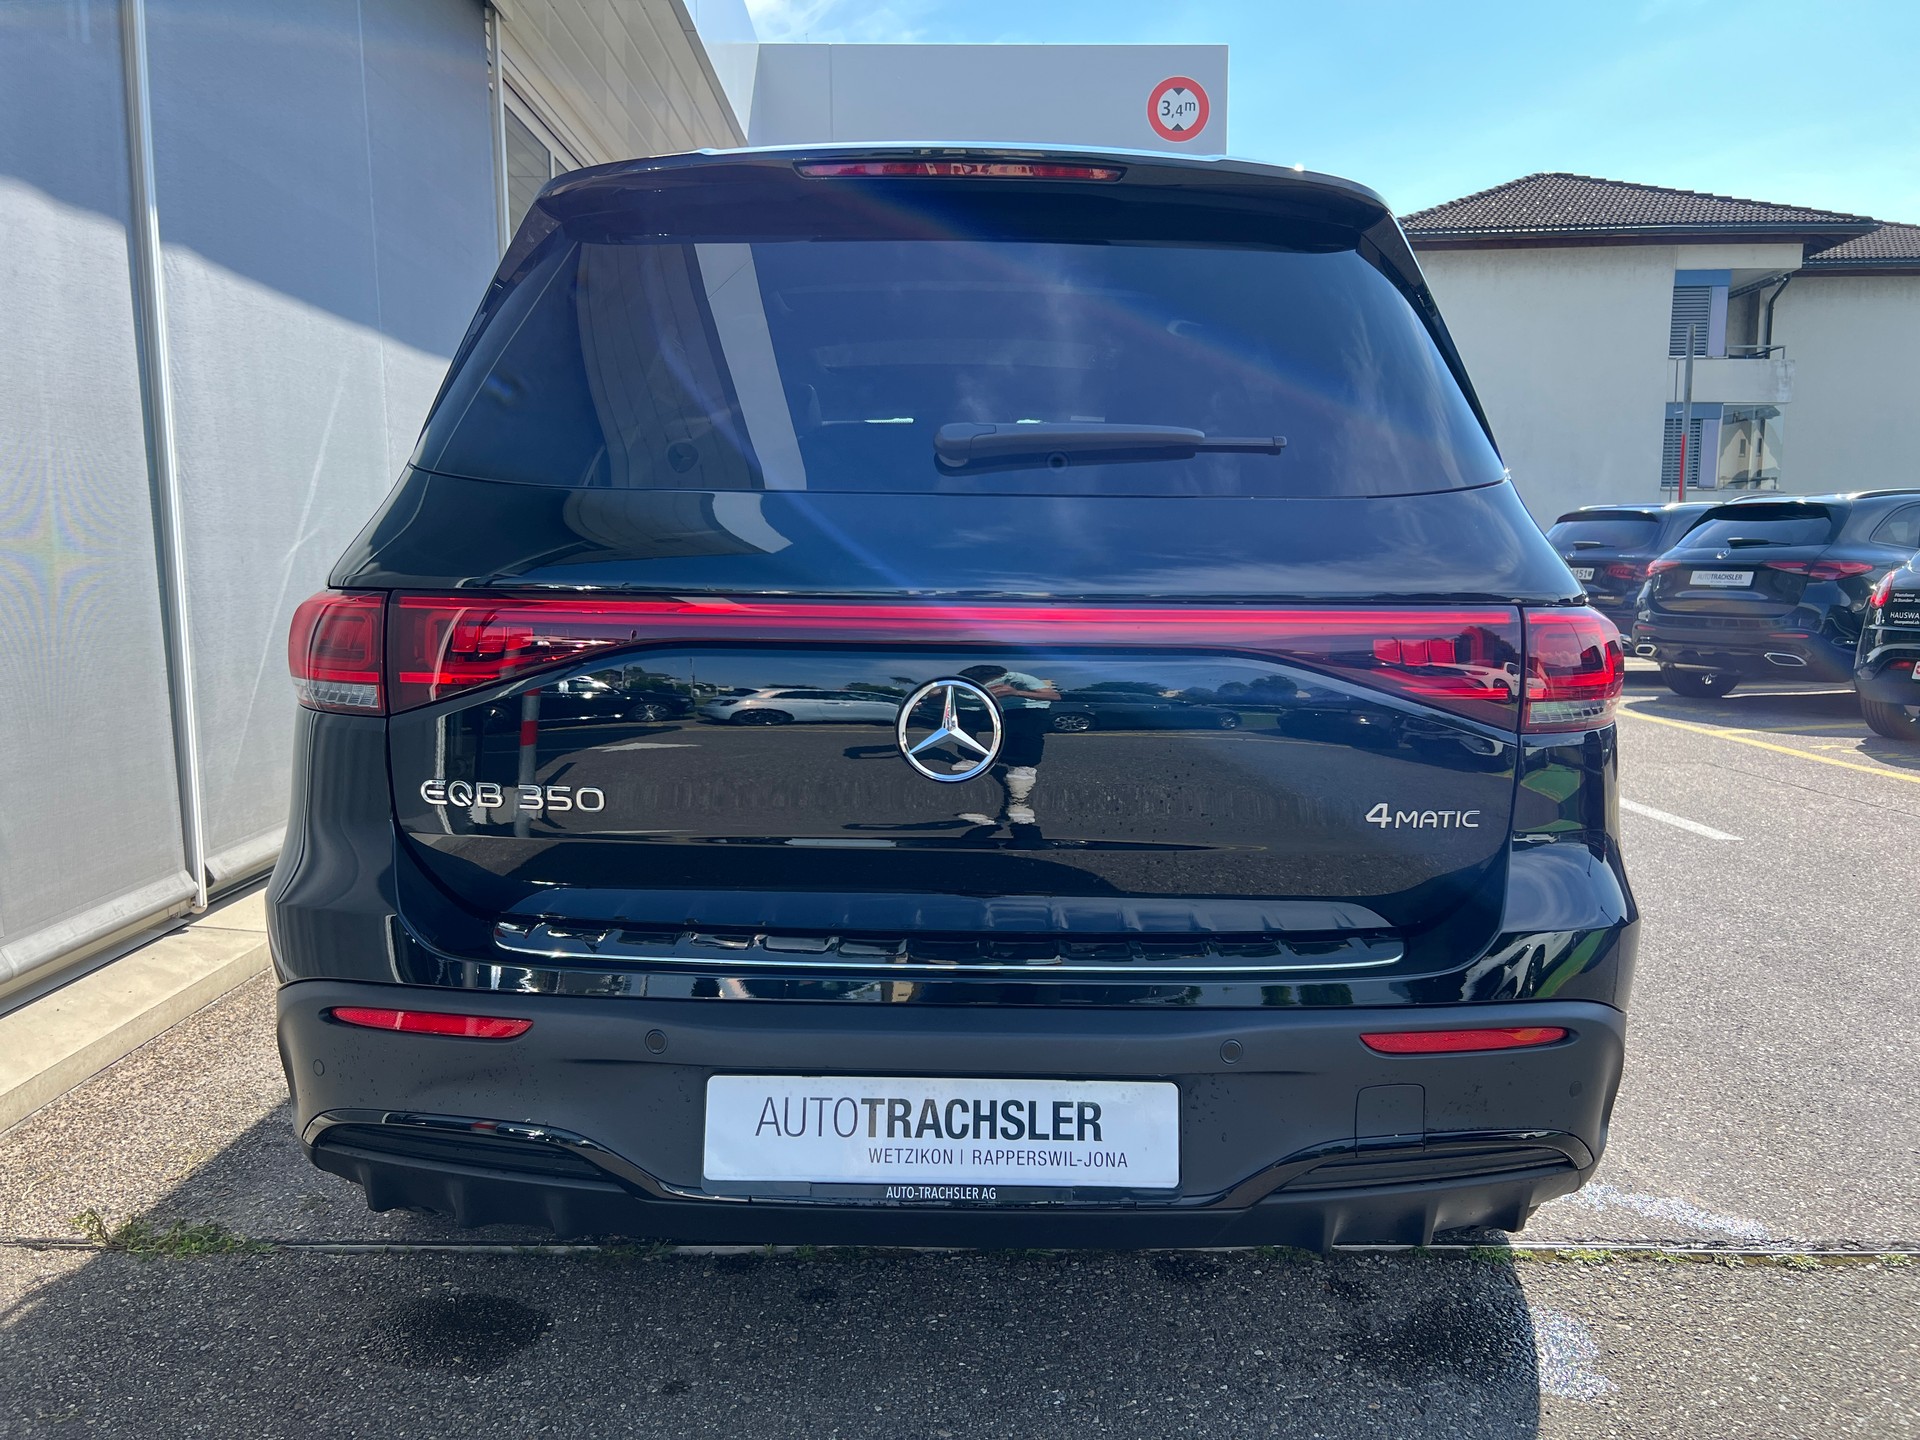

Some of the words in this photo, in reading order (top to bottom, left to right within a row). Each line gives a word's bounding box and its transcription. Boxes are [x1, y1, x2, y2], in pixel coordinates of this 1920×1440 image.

[420, 779, 504, 809] EQB
[518, 784, 606, 813] 350
[1365, 802, 1481, 829] 4MATIC
[754, 1096, 1104, 1143] AUTOTRACHSLER
[868, 1148, 954, 1166] WETZIKON
[972, 1150, 1129, 1169] RAPPERSWIL-JONA
[886, 1186, 979, 1200] AUTO-TRACHSLER
[981, 1187, 997, 1201] AG
